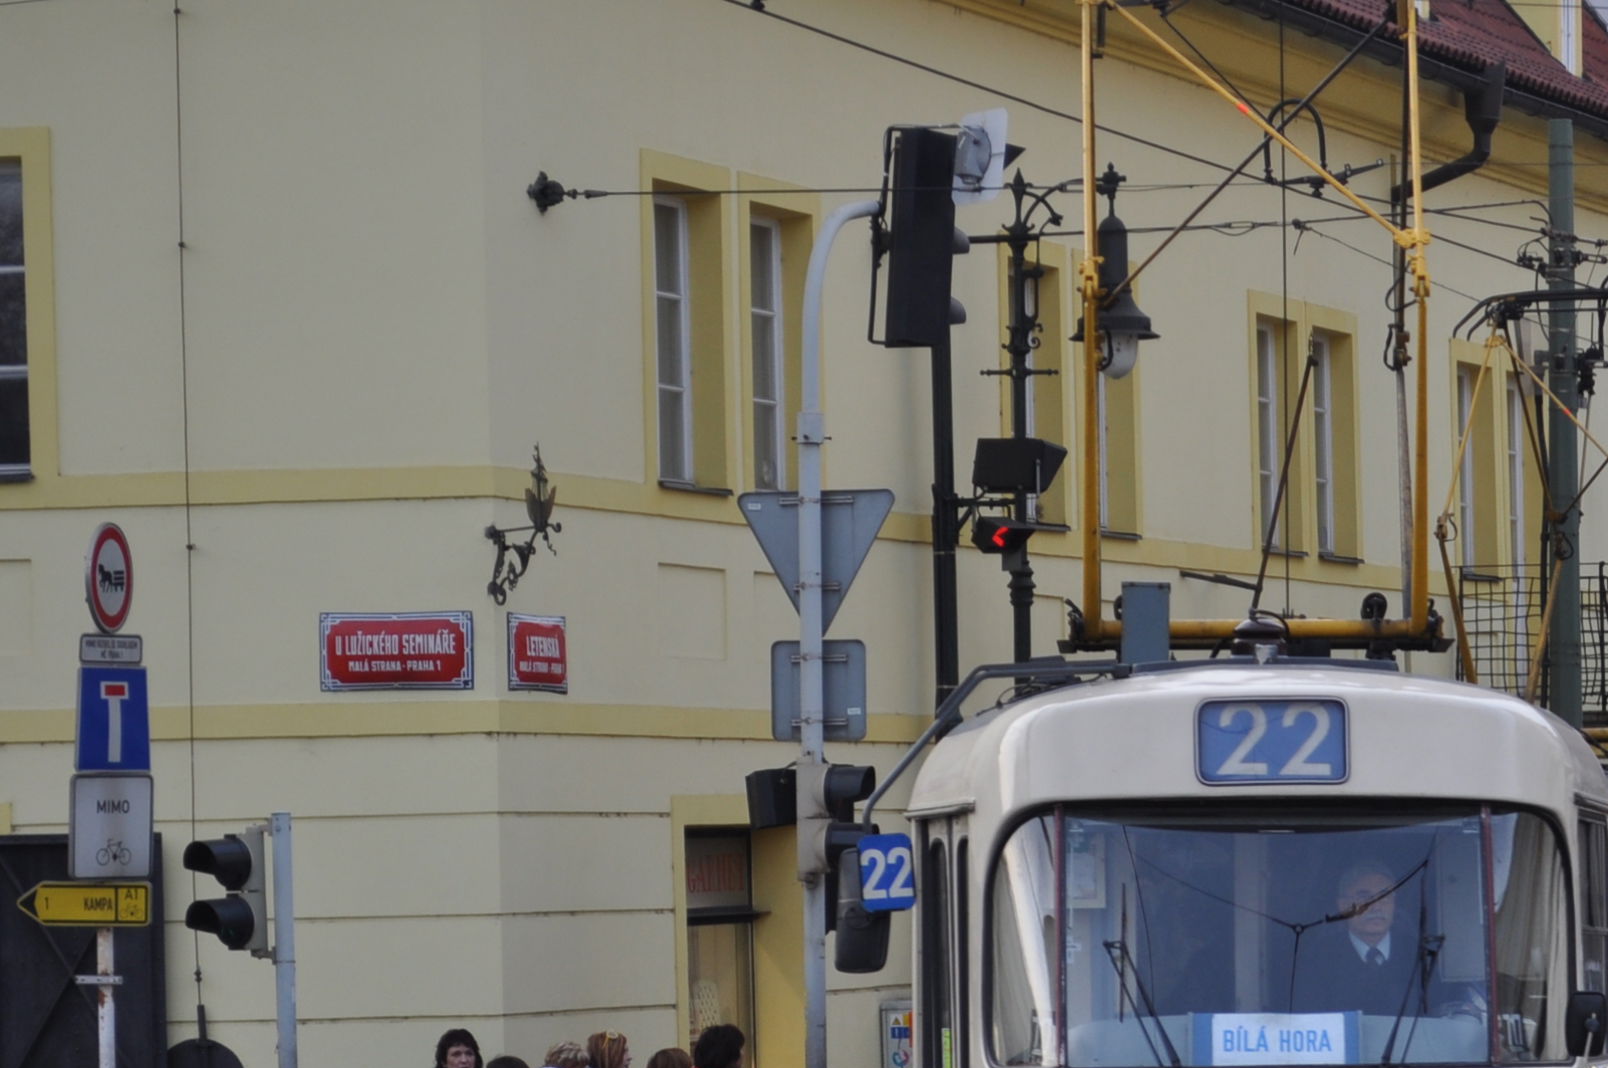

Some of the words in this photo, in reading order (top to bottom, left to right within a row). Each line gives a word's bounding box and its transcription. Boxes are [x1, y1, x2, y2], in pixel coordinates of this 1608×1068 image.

[335, 634, 343, 656] U
[345, 630, 399, 656] LUŽICKÉHO
[402, 629, 456, 655] SEMINÁŘE
[348, 659, 370, 672] MALÁ
[371, 660, 402, 672] STRANA
[406, 660, 434, 672] PRAHA
[1216, 702, 1331, 775] 22
[96, 800, 130, 814] MIMO
[860, 847, 914, 899] 22
[44, 896, 49, 910] 1
[83, 897, 113, 911] KAMPA
[124, 889, 138, 900] A1
[1223, 1025, 1269, 1052] BÍLÁ
[1279, 1030, 1332, 1052] HORA
